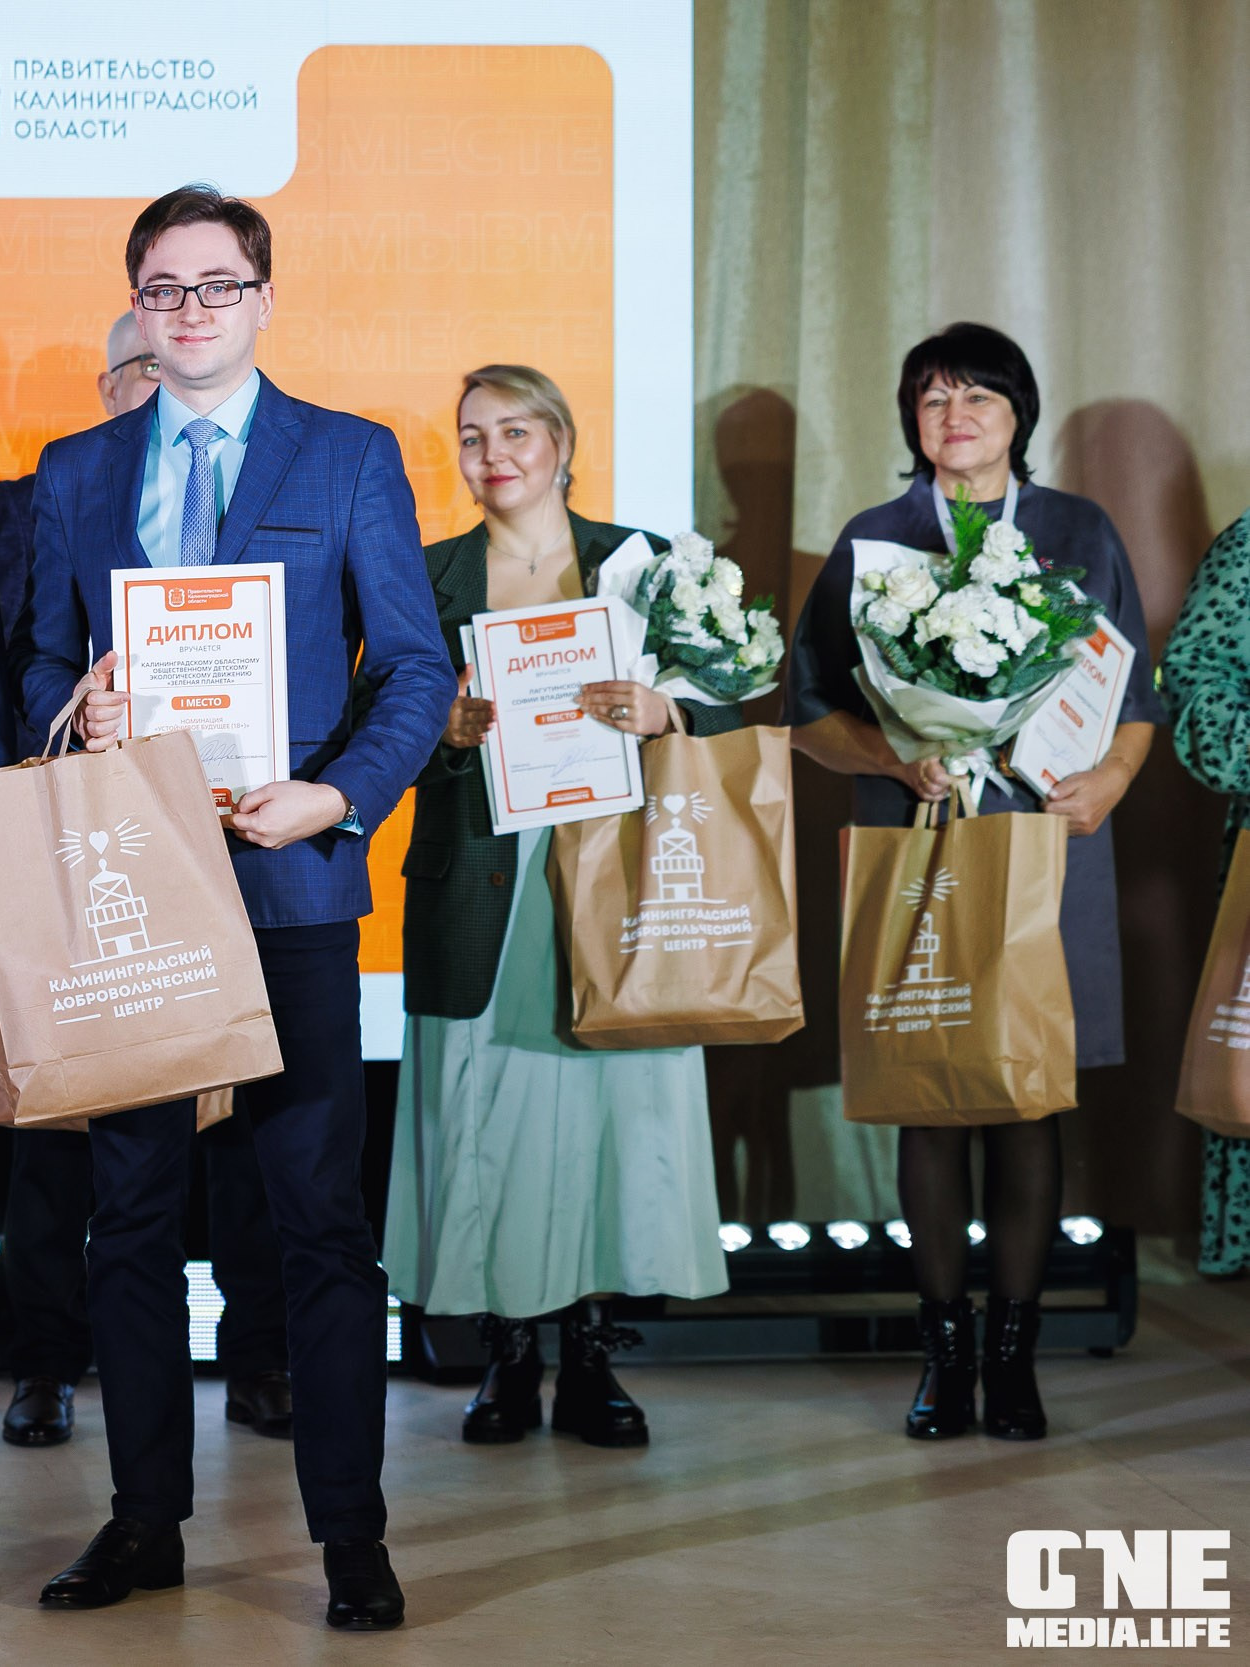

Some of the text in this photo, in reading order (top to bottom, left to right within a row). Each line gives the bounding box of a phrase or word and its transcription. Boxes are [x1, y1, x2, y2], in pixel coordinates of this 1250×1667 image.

[13, 59, 216, 80] ПРАВИТЕЛЬСТВО
[13, 84, 258, 110] КАЛИНИНГРАДСКОЙ
[13, 119, 128, 140] ОБЛАСТИ
[146, 622, 253, 646] ДИПЛОМ
[179, 644, 222, 653] ВРУЧАЕТСЯ
[141, 658, 260, 668] КАЛИНИНГРАДСКОМУ ОБЛАСТНОМУ
[152, 664, 249, 674] ОБЩЕСТВЕННОМУ ДЕТСКОМУ
[507, 646, 597, 675] ДИПЛОМ
[149, 671, 253, 681] ЭКОЛОГИЧЕСКОМУ ДВИЖЕНИЮ
[186, 698, 222, 707] МЕСТО
[511, 696, 539, 706] СОФИИ
[546, 711, 577, 723] МЕСТО
[663, 938, 707, 952] ЦЕНТР
[48, 944, 213, 993] КАЛИНИНГРАДСКИЙ
[52, 962, 218, 1012] ДОБРОВОЛЬЧЕСКИЙ
[865, 983, 972, 1005] КАЛИИНГРАДСКИЙ
[113, 996, 164, 1018] ЦЕНТР
[896, 1020, 932, 1033] ЦЕНТР
